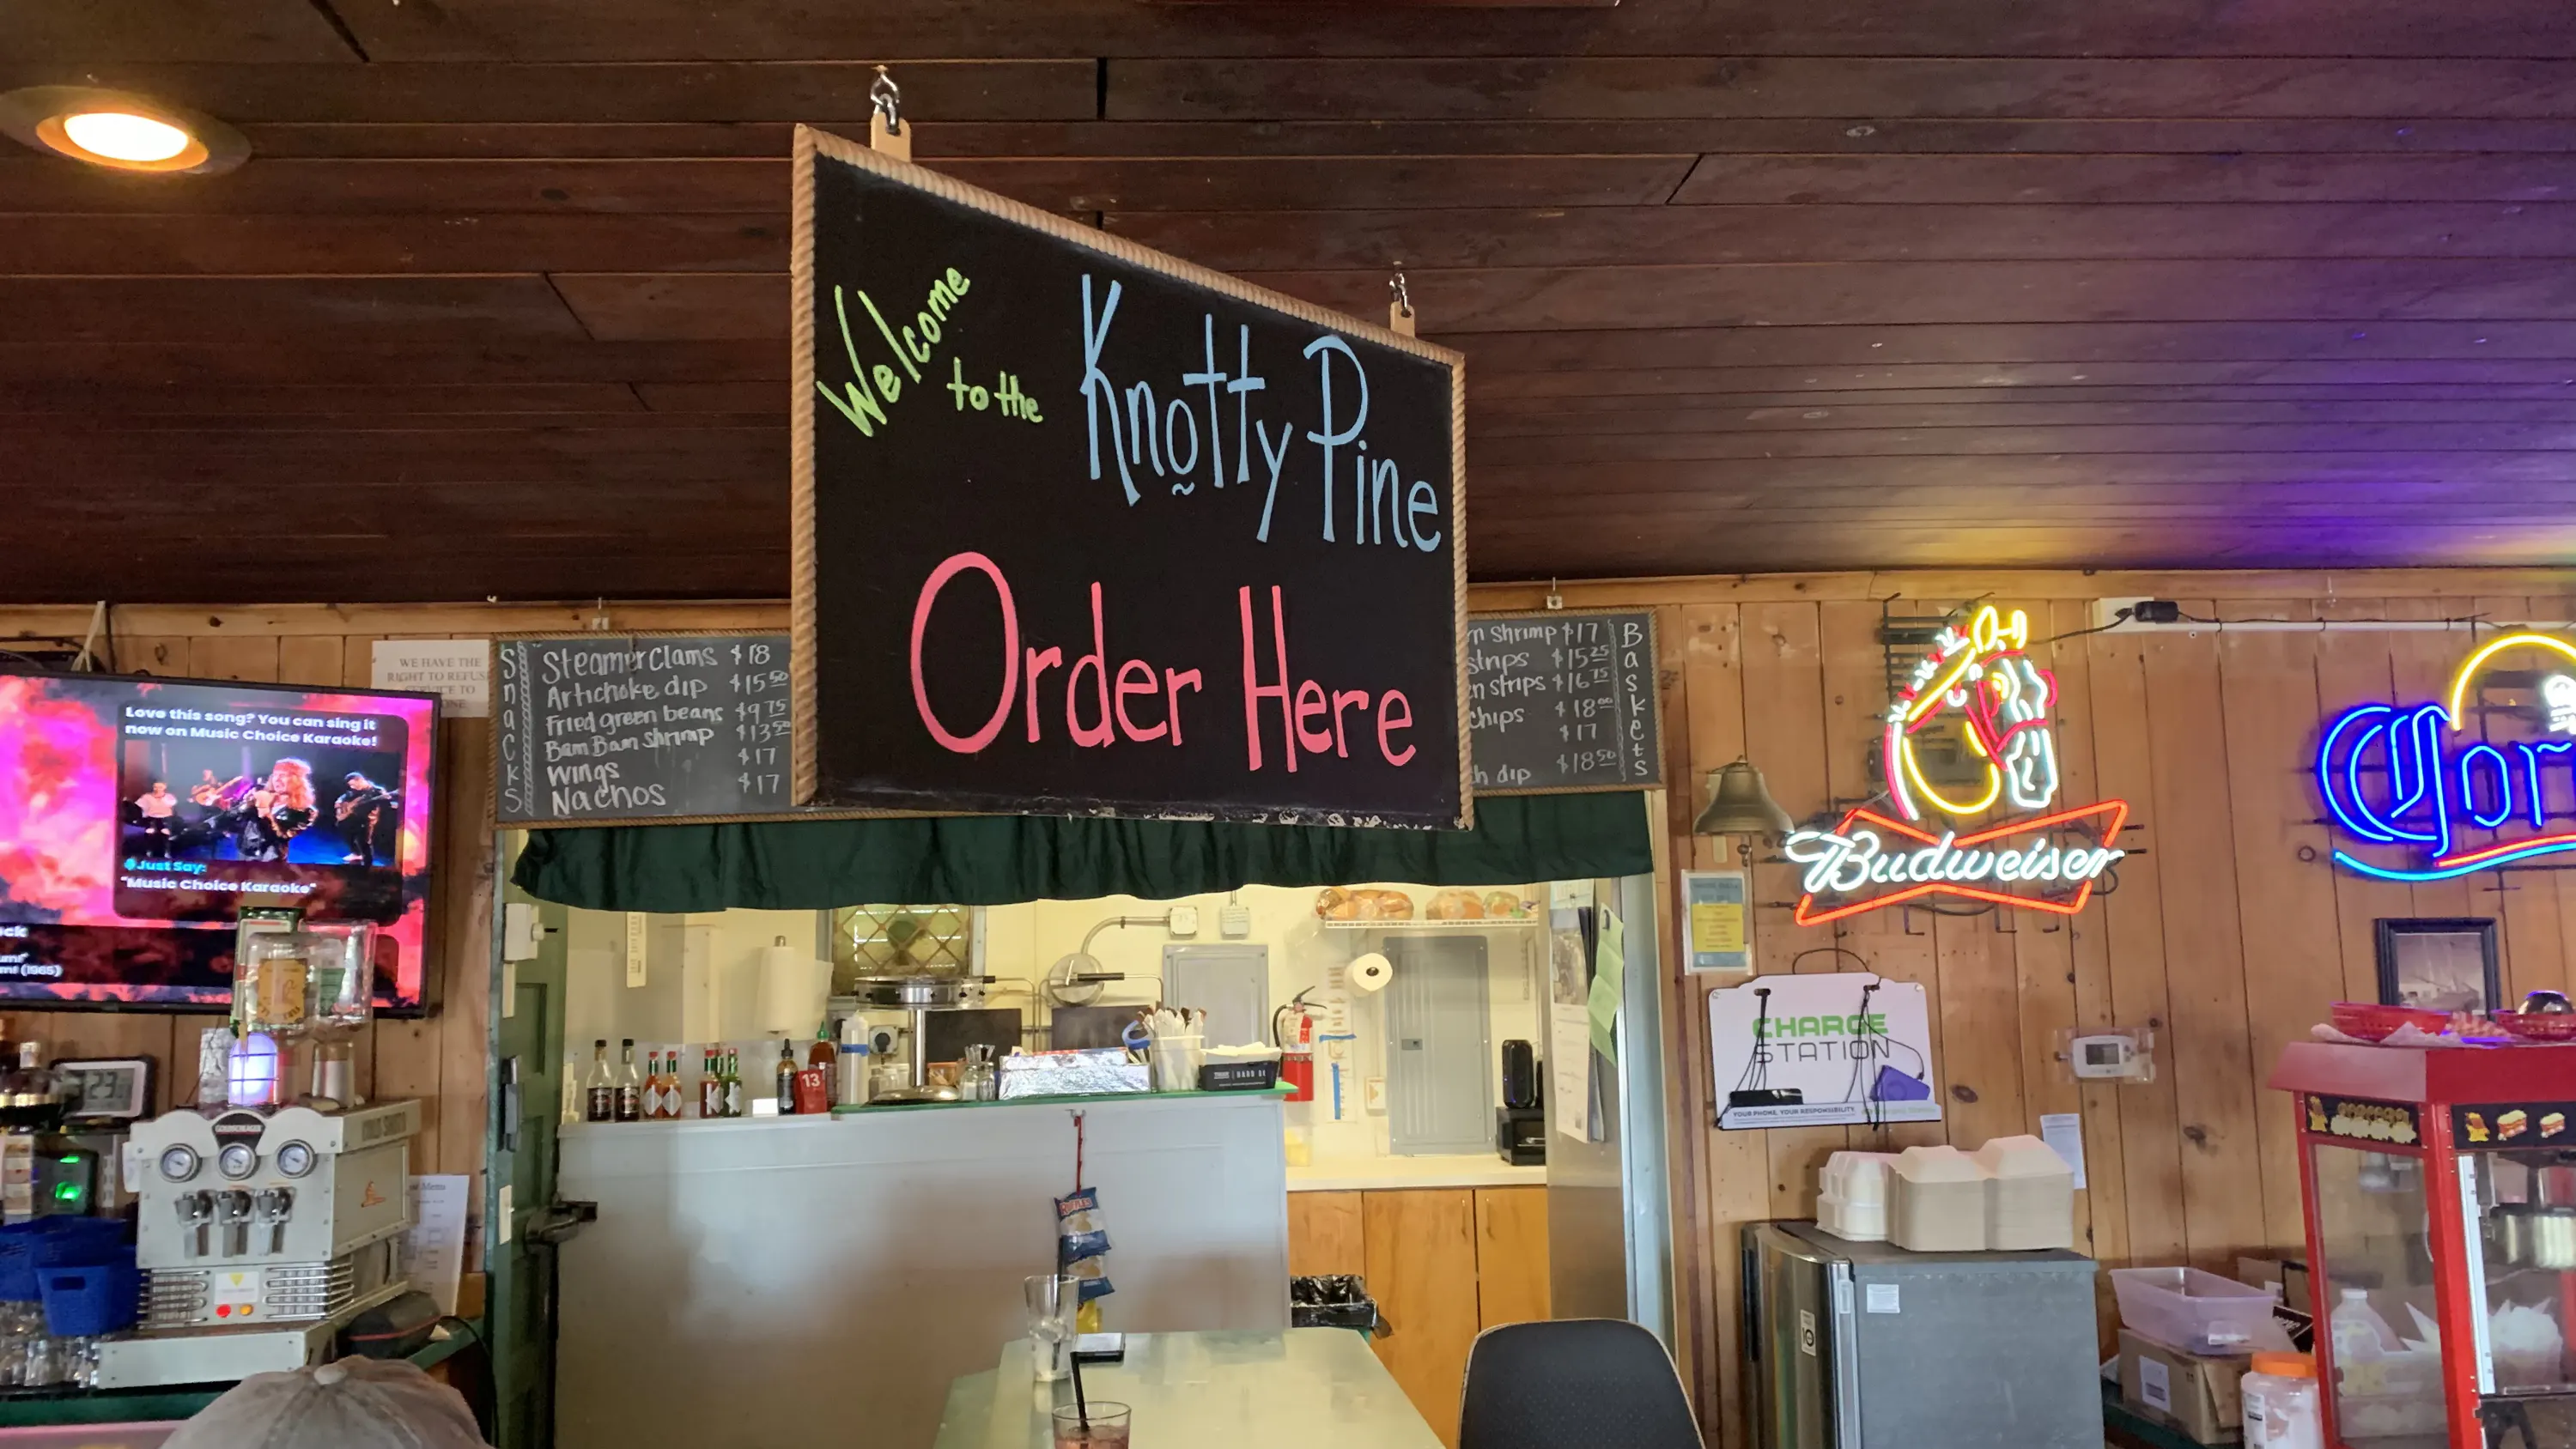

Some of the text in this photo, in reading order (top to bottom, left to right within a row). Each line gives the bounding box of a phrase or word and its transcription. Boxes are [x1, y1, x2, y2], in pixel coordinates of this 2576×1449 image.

[817, 266, 971, 437] Welcome
[946, 357, 1043, 424] to the
[1078, 273, 1443, 553] Knotty Pine
[1490, 621, 1557, 646] shrimp
[399, 657, 482, 668] WE HAVE THE
[542, 647, 646, 685] Steamer
[648, 643, 719, 670] Clams
[910, 550, 1417, 773] Order Here
[386, 670, 489, 682] RIGHT TO REFUS
[460, 685, 475, 695] TO
[547, 677, 659, 712] Artichoke
[665, 675, 708, 700] dip
[125, 706, 376, 732] Love this song? You can sing it
[546, 714, 595, 737] Fried
[599, 707, 658, 736] green
[663, 705, 724, 724] beans
[125, 724, 378, 747] now on Music Choice Karaoke!
[642, 728, 714, 749] shrimp
[1496, 764, 1532, 786] dip
[2321, 705, 2576, 858] Cor
[551, 783, 667, 815] Nachos
[137, 860, 207, 875] Just Say:
[1785, 830, 2126, 894] Budweiser
[120, 876, 317, 894] "Music Choice Karaoke"
[1752, 1013, 1889, 1039] CHARGE
[1754, 1039, 1890, 1064] STATION
[800, 1072, 821, 1088] 13
